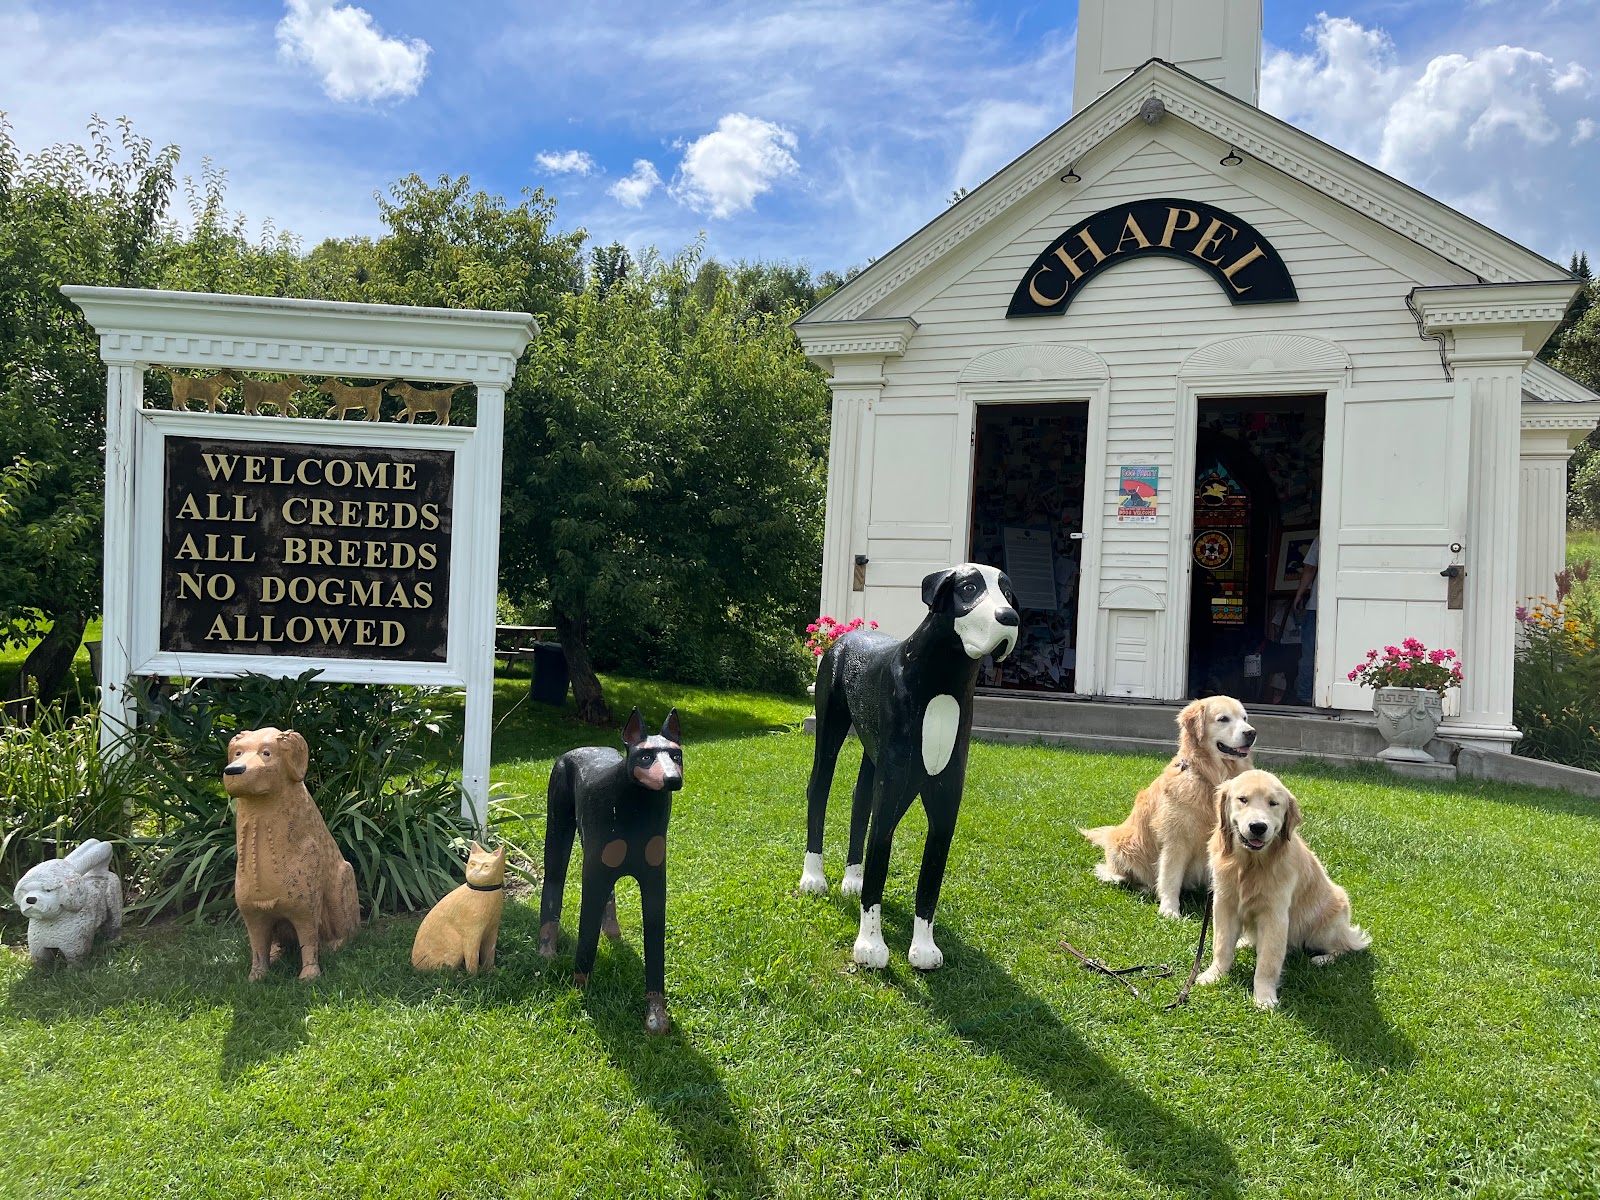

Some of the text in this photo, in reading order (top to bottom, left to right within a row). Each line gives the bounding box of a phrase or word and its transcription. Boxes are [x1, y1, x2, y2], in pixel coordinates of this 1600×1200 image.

[1028, 206, 1268, 307] CHAPEL
[201, 453, 417, 490] WELCOME
[175, 492, 440, 531] ALL CREEDS
[174, 532, 438, 570] ALL BREEDS
[176, 572, 434, 609] NO DOGMAS
[204, 613, 406, 647] ALLOWED
